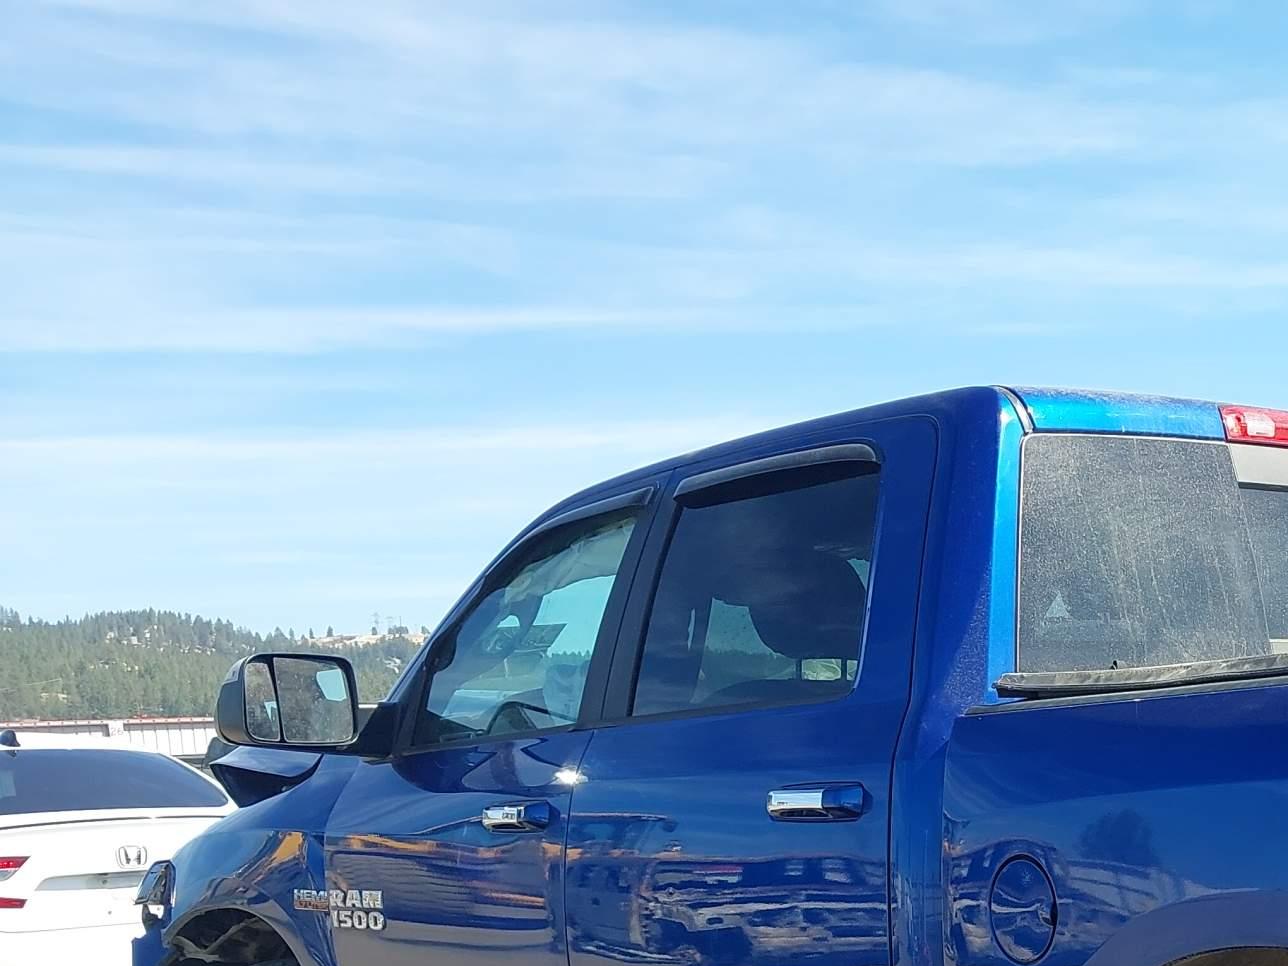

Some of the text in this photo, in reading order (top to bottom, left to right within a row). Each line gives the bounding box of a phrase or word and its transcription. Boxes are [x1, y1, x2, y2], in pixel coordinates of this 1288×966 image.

[293, 888, 328, 901] HEMI
[329, 889, 384, 909] RAM
[331, 909, 386, 931] 1500
